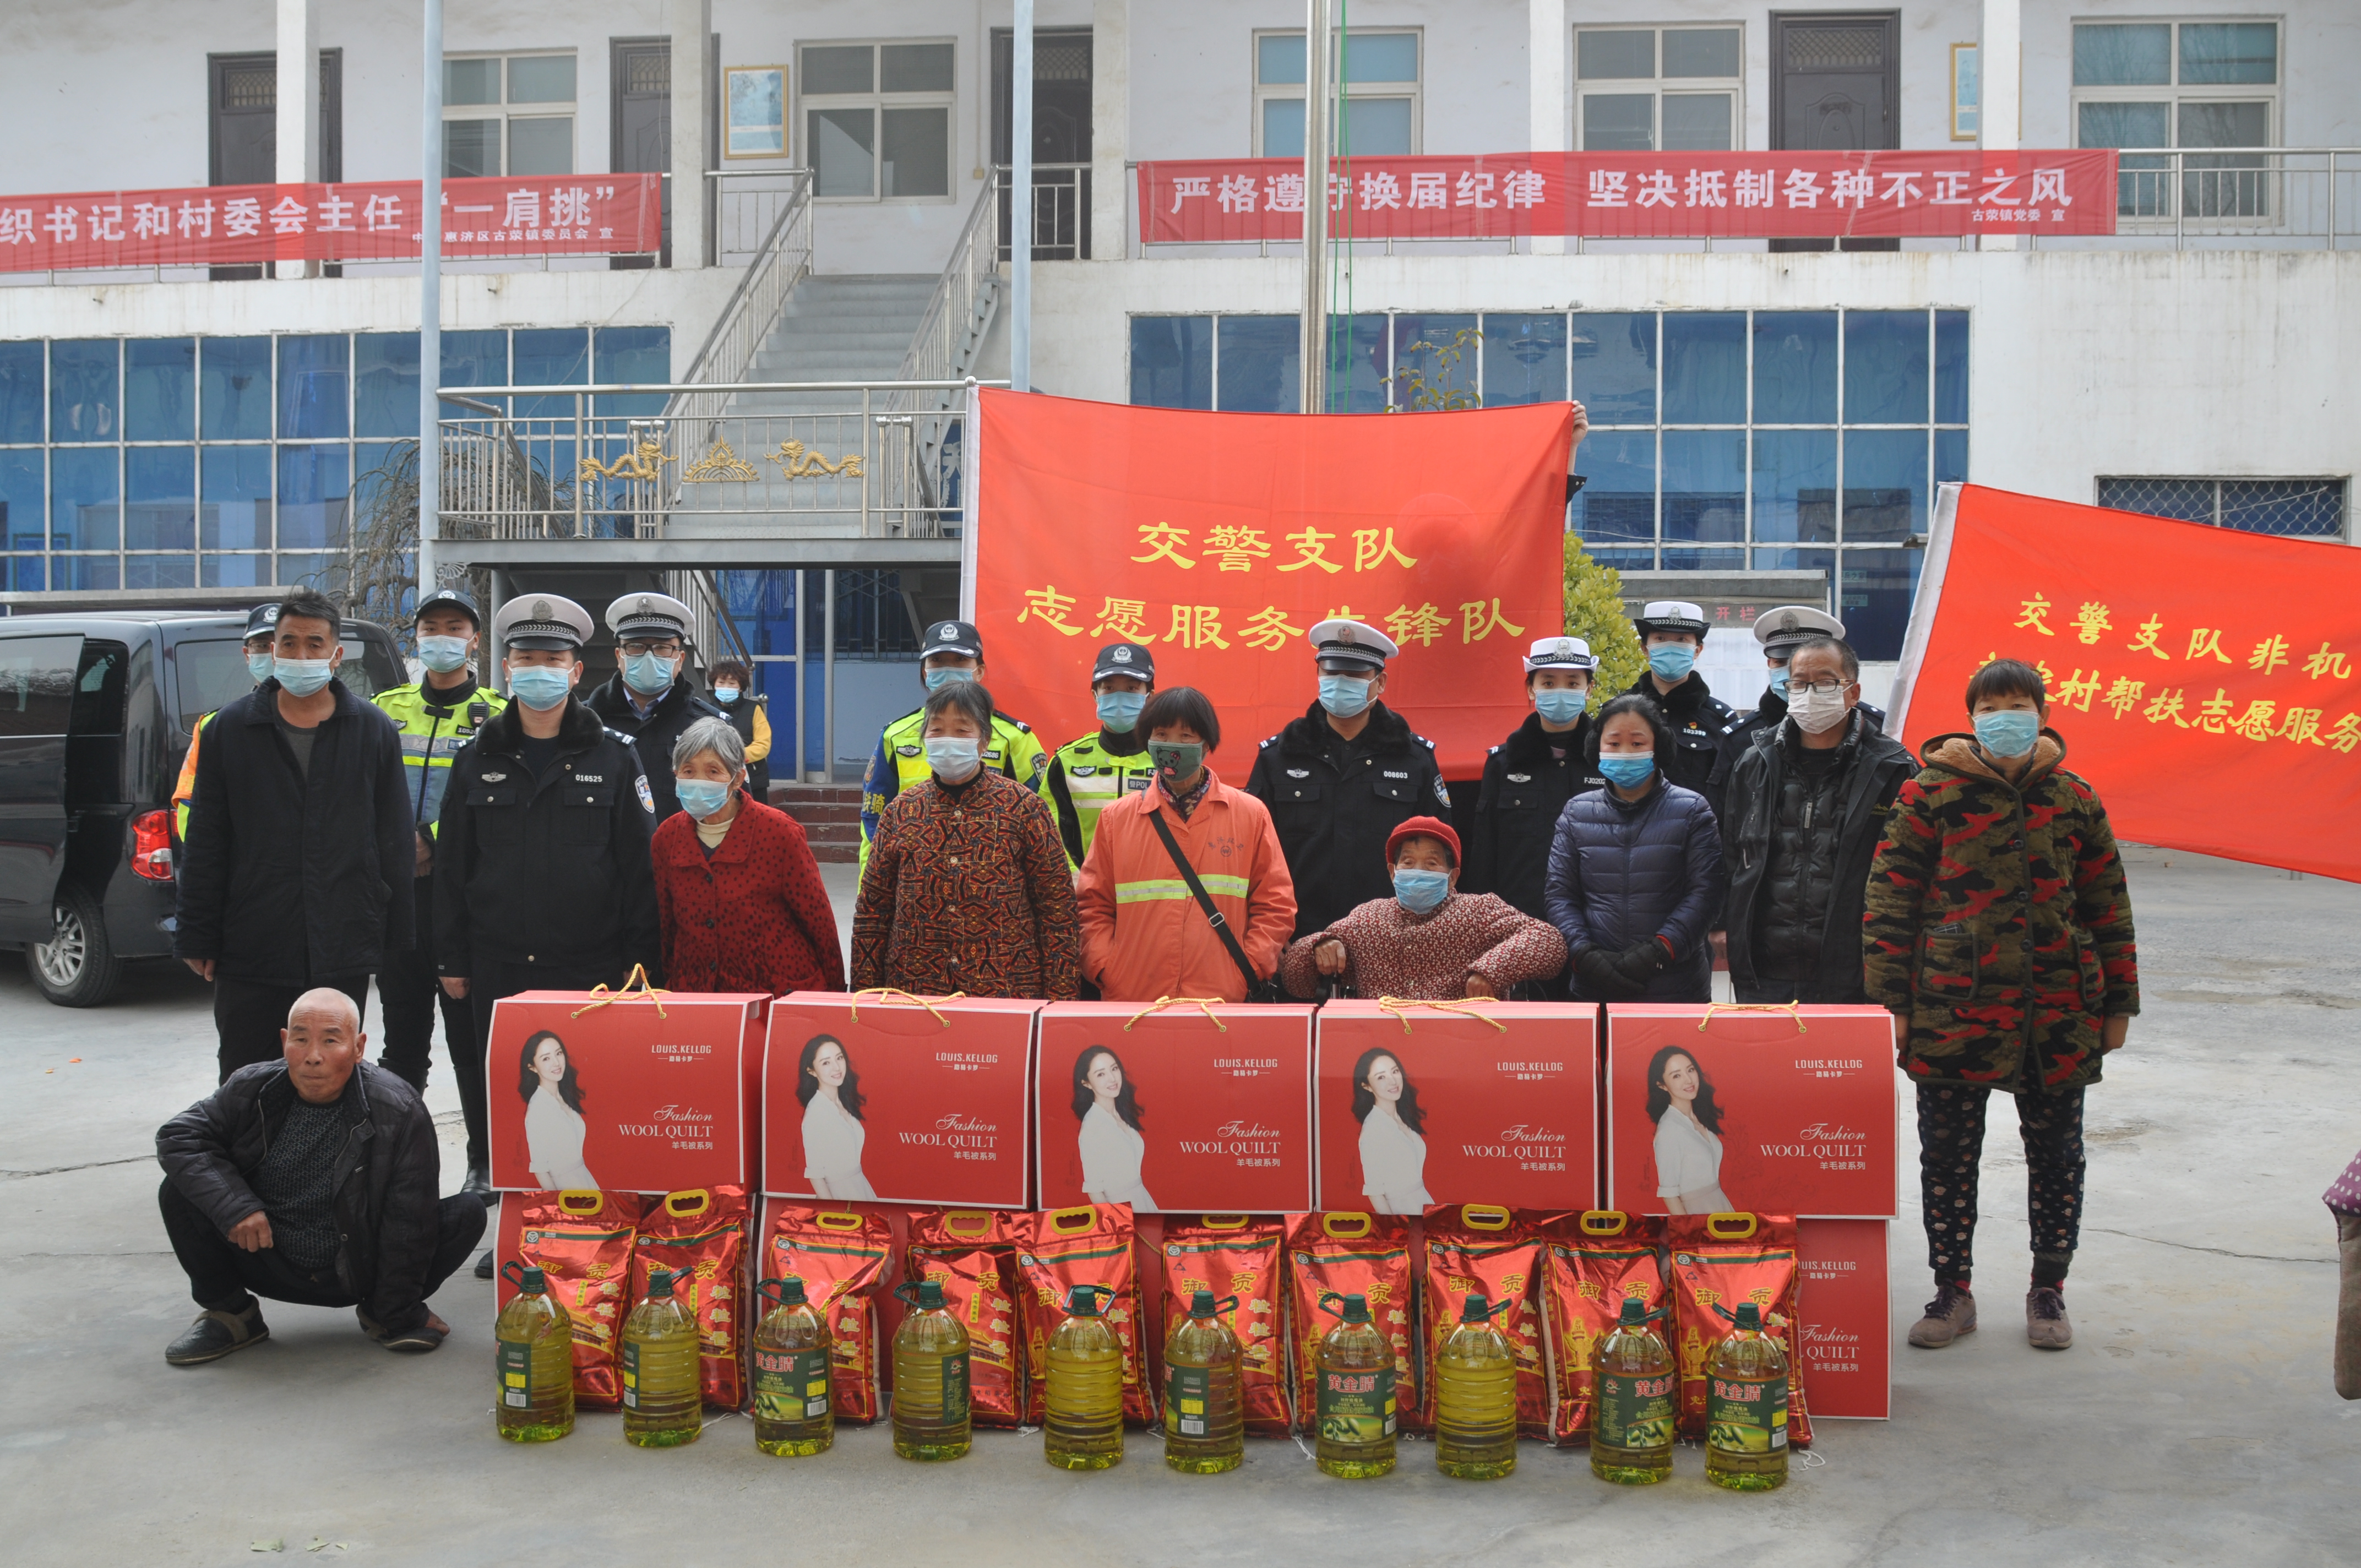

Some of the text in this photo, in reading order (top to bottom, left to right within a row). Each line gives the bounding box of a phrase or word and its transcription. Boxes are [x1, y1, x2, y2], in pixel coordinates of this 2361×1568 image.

[1587, 168, 2072, 208] 坚决抵制各种不正之风
[2051, 209, 2065, 221] 宣
[412, 227, 613, 244] 中惠济区古荥镇委员会 宣
[1130, 521, 1418, 574] 交警支队
[1702, 606, 1755, 621] 开栏
[2014, 592, 2351, 680] 交警支队非机
[575, 774, 602, 782] 016525
[1384, 771, 1408, 779] 008603
[651, 1045, 711, 1054] LOUIS.KELLOG
[936, 1052, 998, 1063] LOUIS.KELLOG
[1214, 1059, 1278, 1068] LOUIS.KELLOG
[1795, 1059, 1863, 1069] LOUIS.KELLOG
[1497, 1062, 1563, 1071] LOUIS.KELLOG
[654, 1104, 713, 1121] Fashion
[935, 1114, 997, 1132] Fashion
[1217, 1120, 1281, 1137] Fashion
[618, 1125, 714, 1139] WOOL QUILT
[1501, 1125, 1566, 1142] Fashion
[1800, 1123, 1866, 1140] Fashion
[672, 1141, 713, 1150] 羊毛被系列
[899, 1132, 997, 1148] WOOL QUILT
[1179, 1141, 1281, 1156] WOOL QUILT
[1462, 1145, 1566, 1159] WOOL QUILT
[1760, 1145, 1867, 1159] WOOL QUILT
[954, 1151, 997, 1161] 羊毛被系列
[1237, 1158, 1280, 1167] 羊毛被系列
[1521, 1162, 1565, 1171] 羊毛被系列
[1820, 1162, 1866, 1170] 羊毛被系列
[1798, 1261, 1856, 1270] UIS.KELLOG
[1800, 1325, 1859, 1342] Fashion
[1807, 1346, 1859, 1360] QUILT
[1813, 1363, 1858, 1371] 羊毛被系列
[1328, 1374, 1375, 1393] 黄金晴
[1713, 1380, 1761, 1402] 黄金晴
